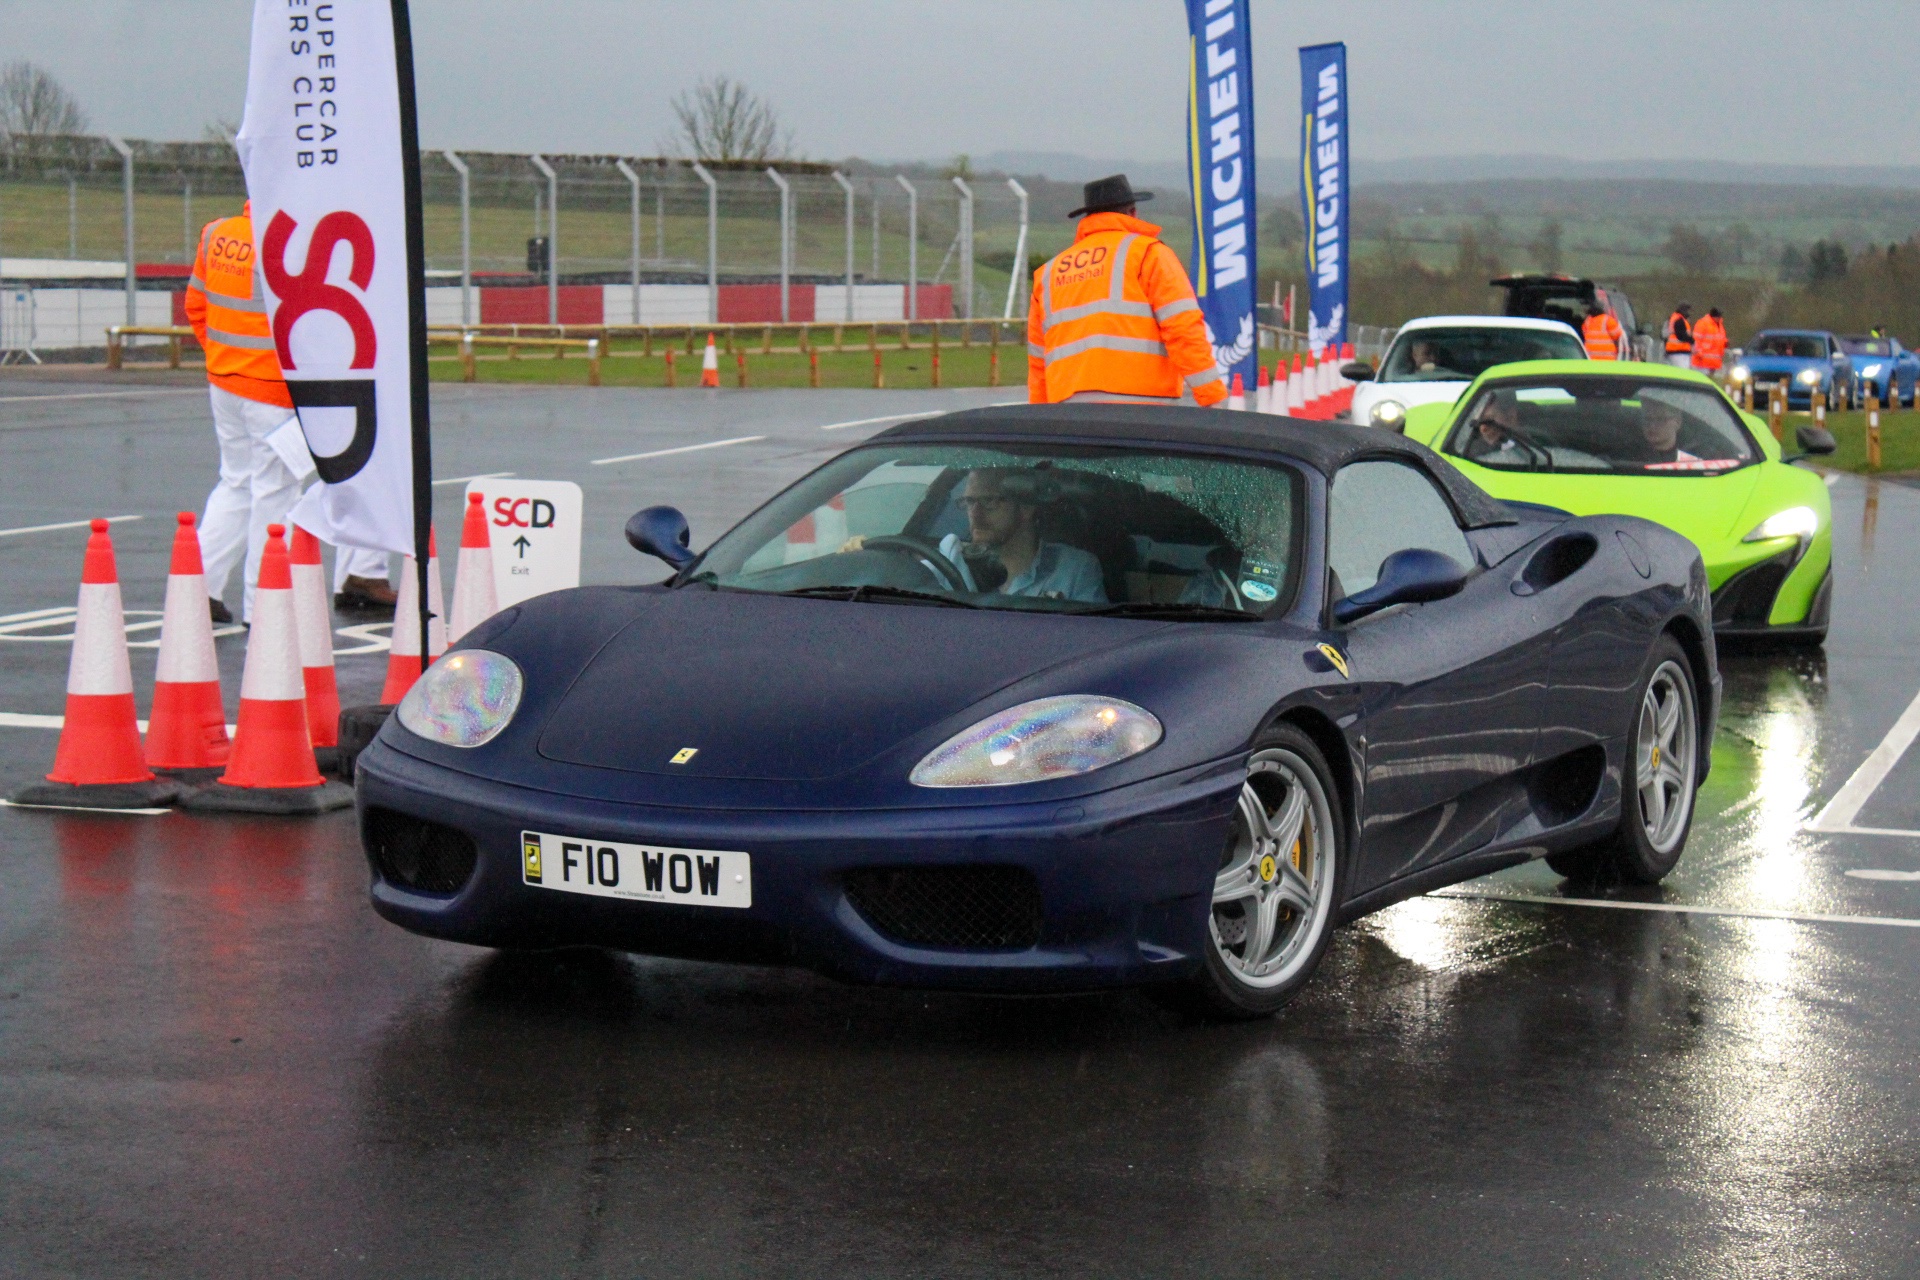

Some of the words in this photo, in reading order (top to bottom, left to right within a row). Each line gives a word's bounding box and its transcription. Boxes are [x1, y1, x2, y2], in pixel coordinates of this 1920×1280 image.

[315, 4, 338, 166] UPERCAR
[293, 76, 314, 169] CLUB
[213, 237, 252, 262] SCD
[1057, 246, 1107, 273] SCD
[210, 257, 245, 277] Marshal
[1055, 264, 1105, 287] Marshal
[262, 208, 377, 484] SCD
[511, 565, 530, 575] Exit
[562, 842, 619, 888] F10
[641, 851, 720, 896] WOW
